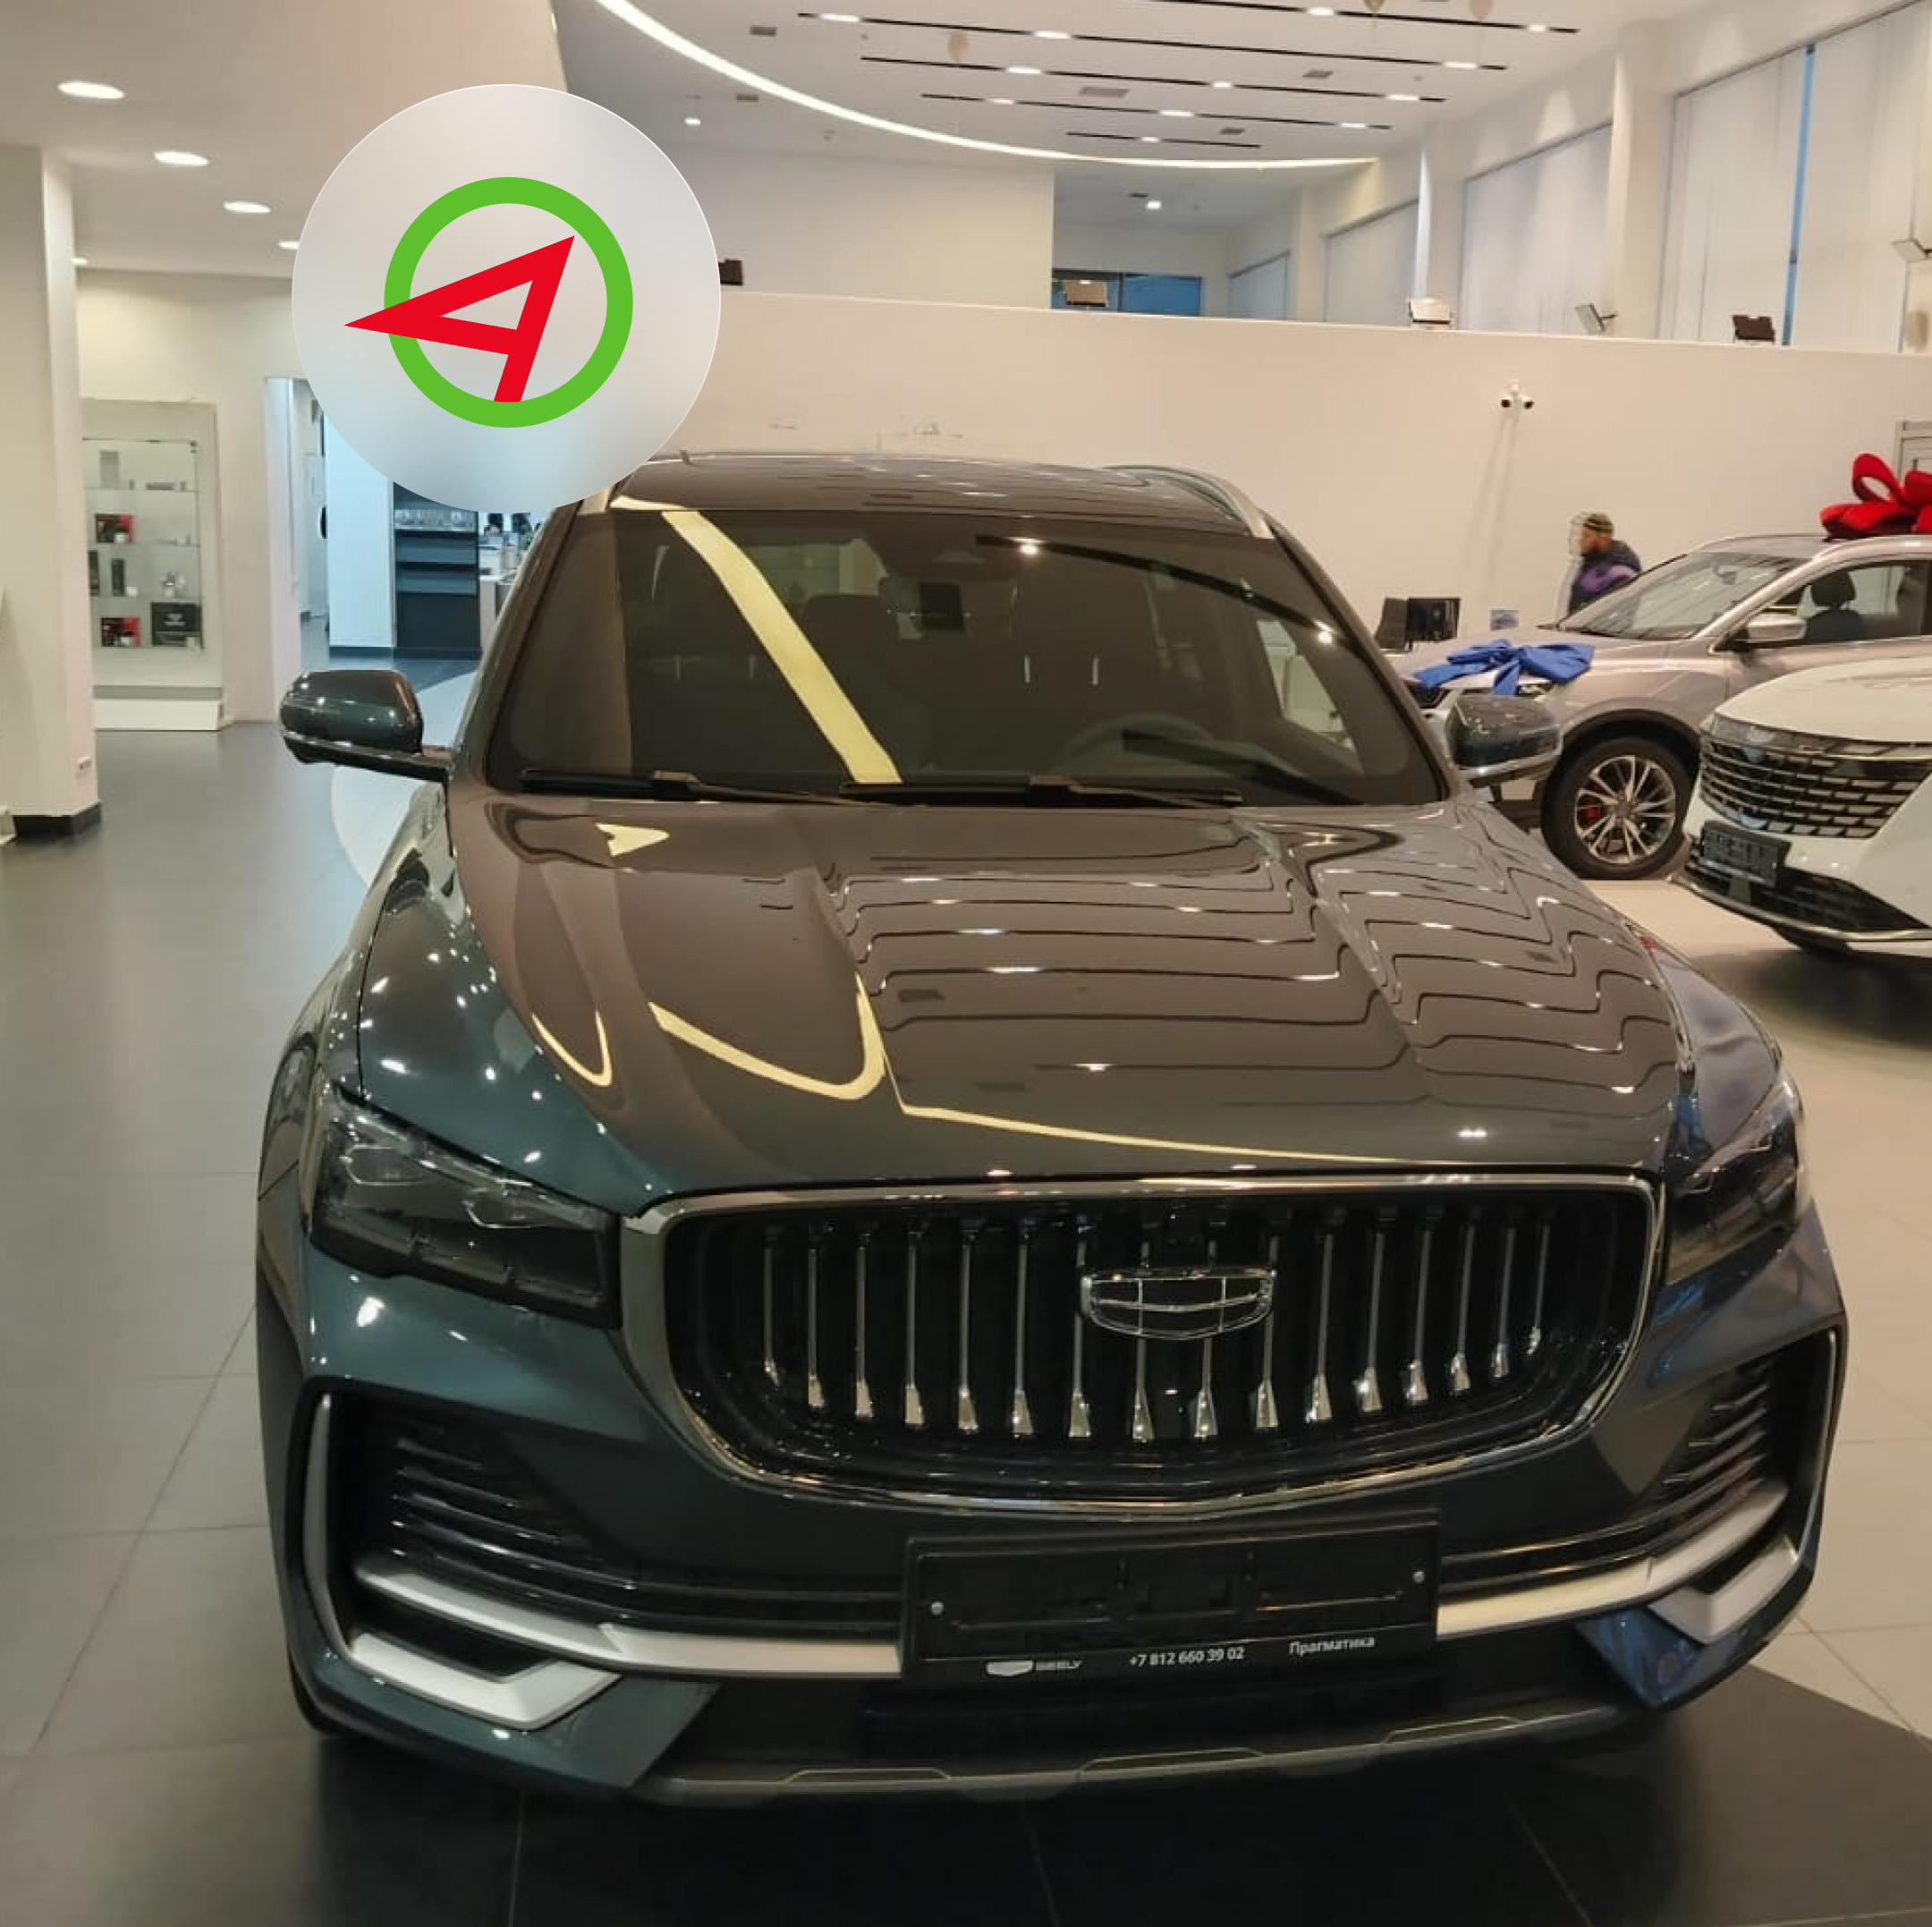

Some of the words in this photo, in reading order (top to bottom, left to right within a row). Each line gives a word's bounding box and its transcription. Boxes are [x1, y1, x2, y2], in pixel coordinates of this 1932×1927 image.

[1129, 1653, 1147, 1667] +7
[1149, 1651, 1176, 1665] 812
[1178, 1650, 1205, 1663] 660
[1207, 1648, 1224, 1661] 39
[1226, 1646, 1245, 1660] 02
[1289, 1636, 1375, 1657] Прагматика
